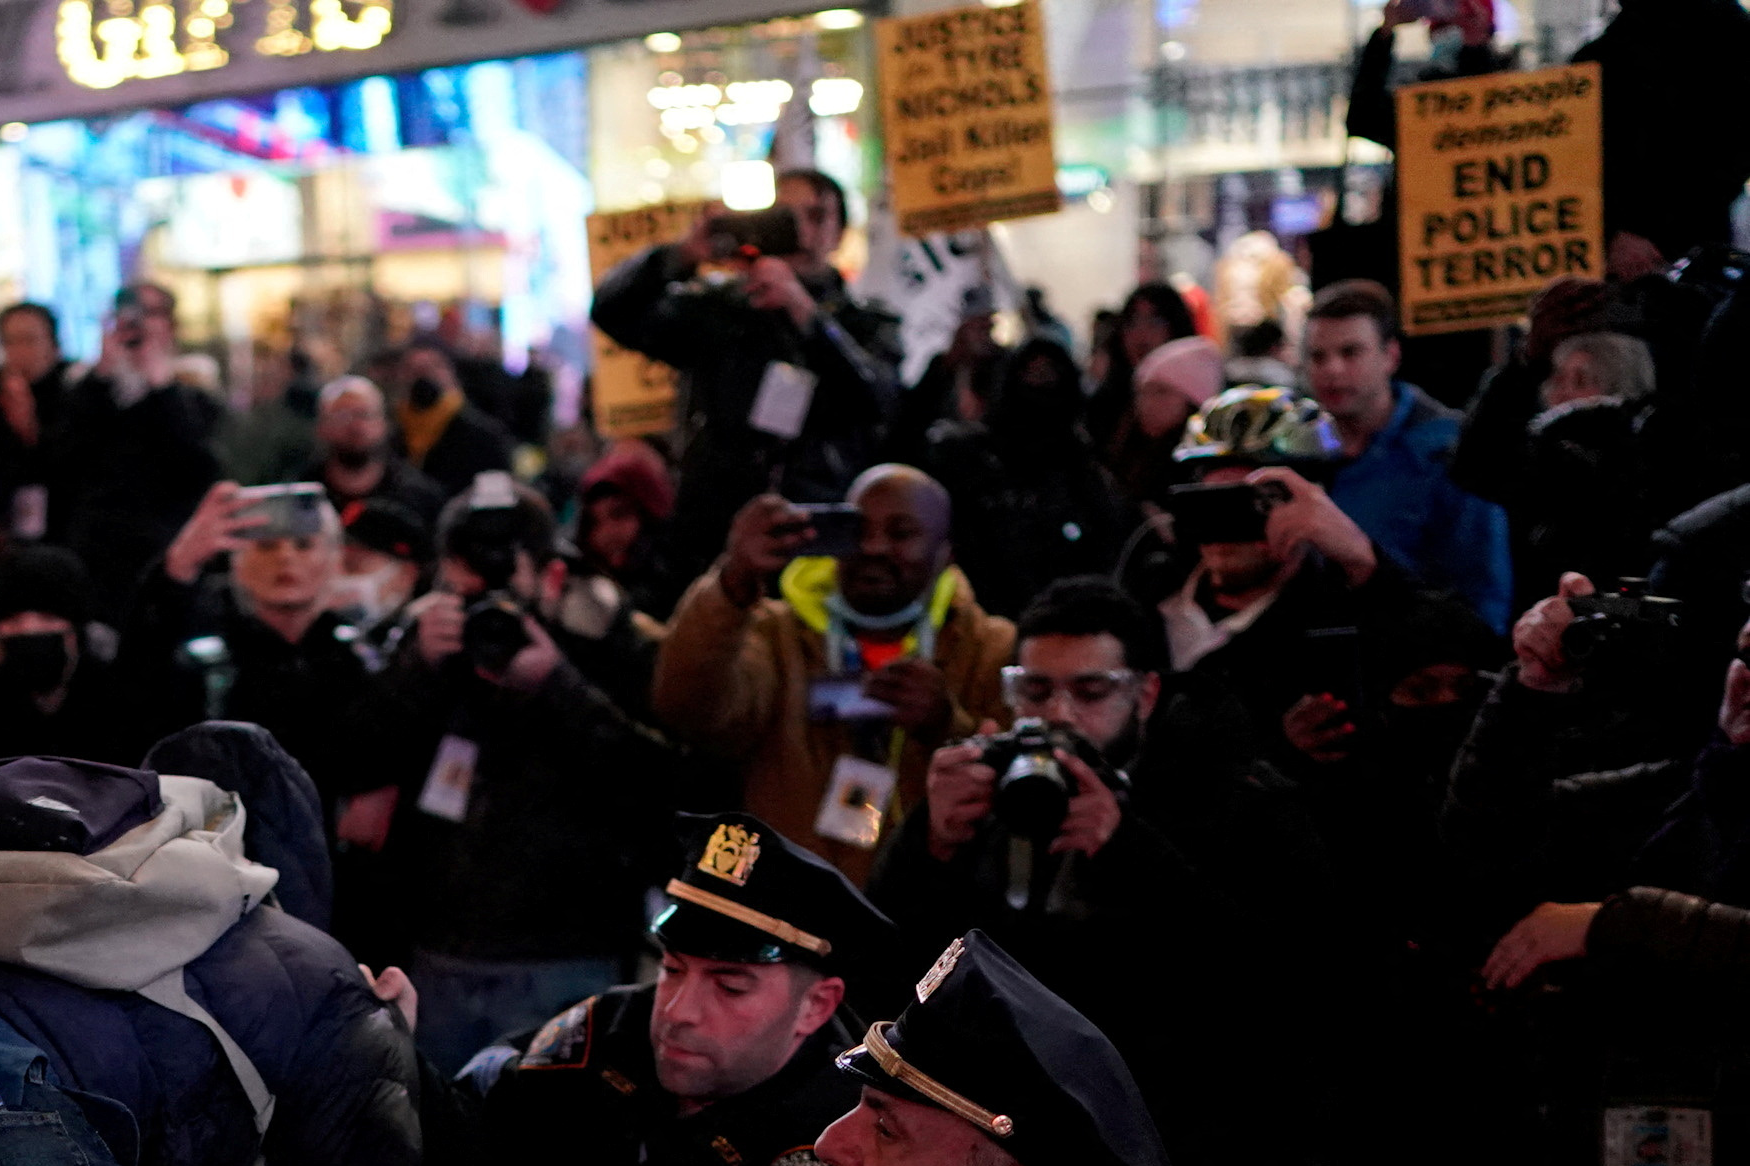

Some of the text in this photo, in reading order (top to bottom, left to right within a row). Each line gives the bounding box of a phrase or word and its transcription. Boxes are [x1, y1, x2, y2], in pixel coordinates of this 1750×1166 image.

[897, 73, 1040, 118] NICHOLS
[1415, 72, 1591, 119] The people
[1452, 152, 1550, 199] END
[1423, 196, 1583, 248] POLICE
[1415, 239, 1591, 291] TERROR
